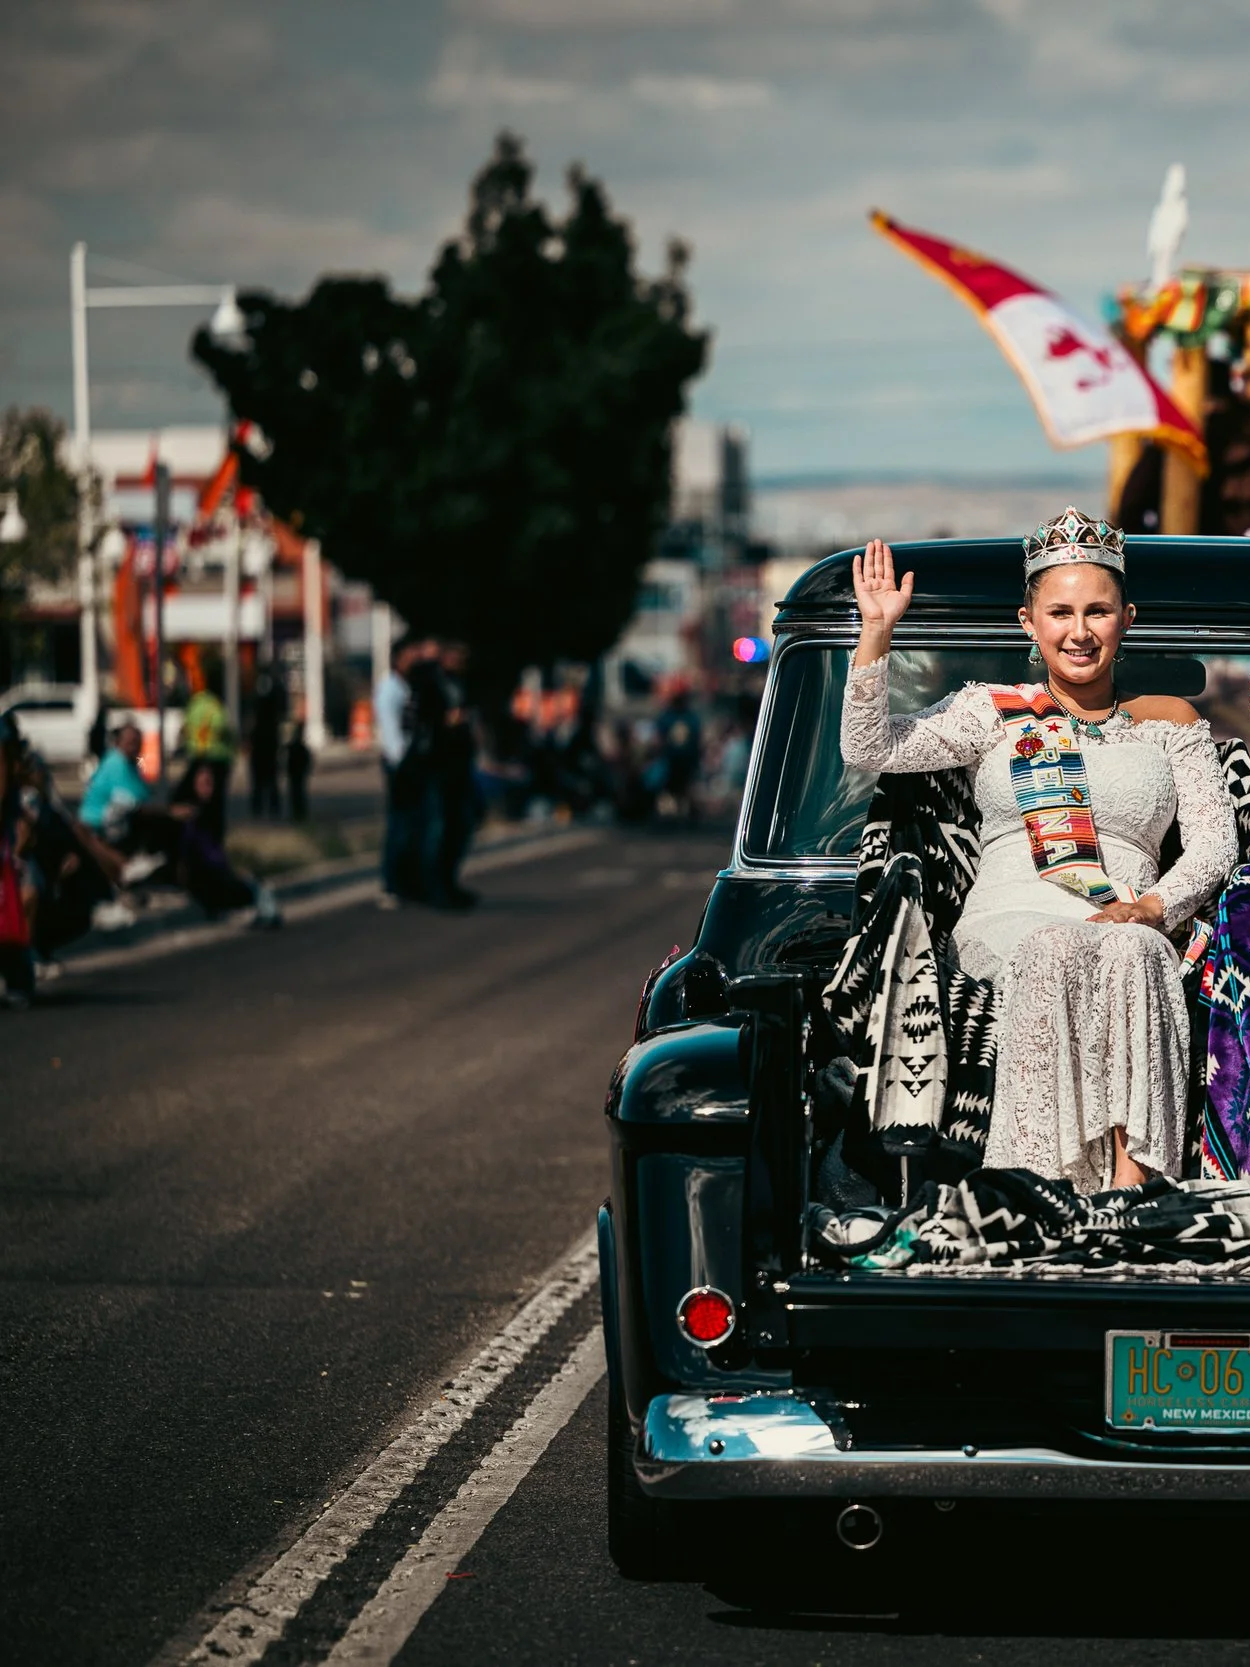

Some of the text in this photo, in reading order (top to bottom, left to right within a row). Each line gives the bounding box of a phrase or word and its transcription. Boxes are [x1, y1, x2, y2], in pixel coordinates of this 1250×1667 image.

[1030, 746, 1078, 865] REINA
[1128, 1347, 1172, 1395] HC
[1162, 1408, 1197, 1419] NEW
